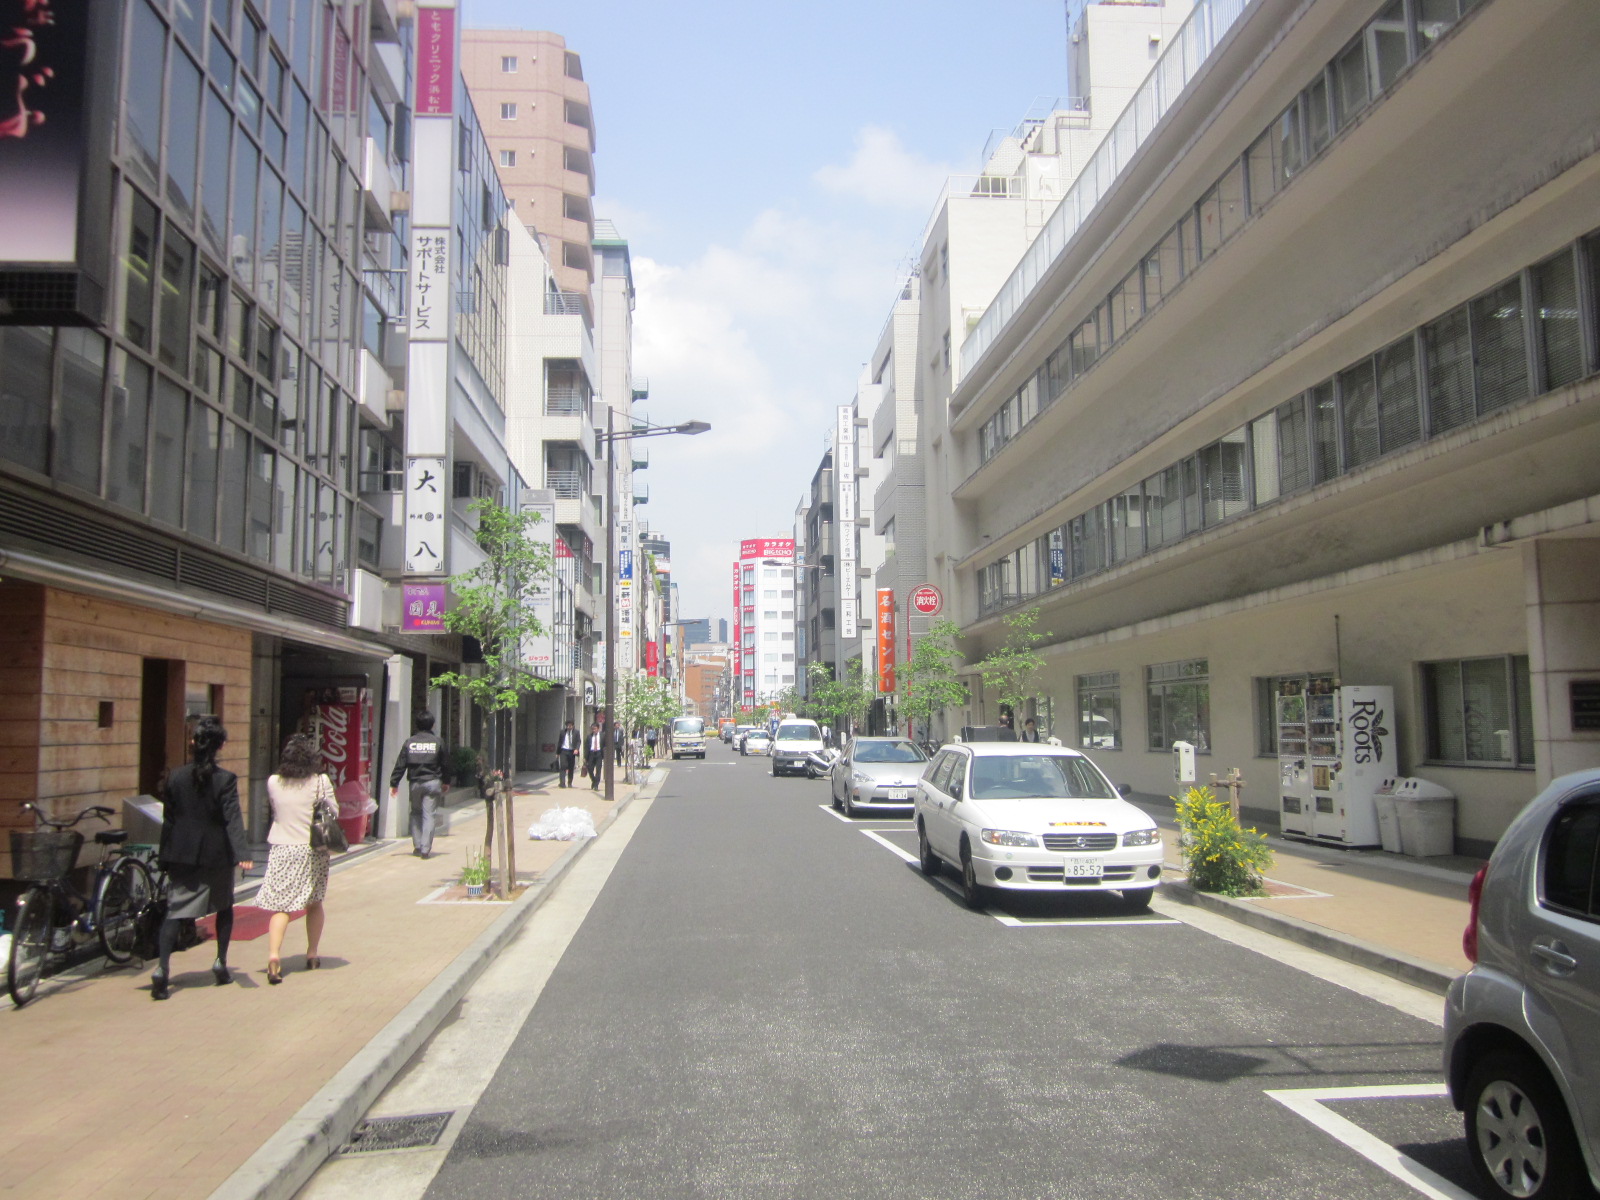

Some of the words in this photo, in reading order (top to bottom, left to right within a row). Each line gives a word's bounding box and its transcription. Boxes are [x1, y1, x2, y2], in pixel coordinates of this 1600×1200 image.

[427, 10, 442, 113] ともクリニック浜松町
[434, 236, 446, 274] 株式会社
[415, 236, 433, 330] サポートサービス
[916, 596, 937, 606] 消火栓
[879, 595, 893, 687] 名酒センター
[409, 742, 437, 751] CBRE
[1073, 865, 1102, 876] 85-52
